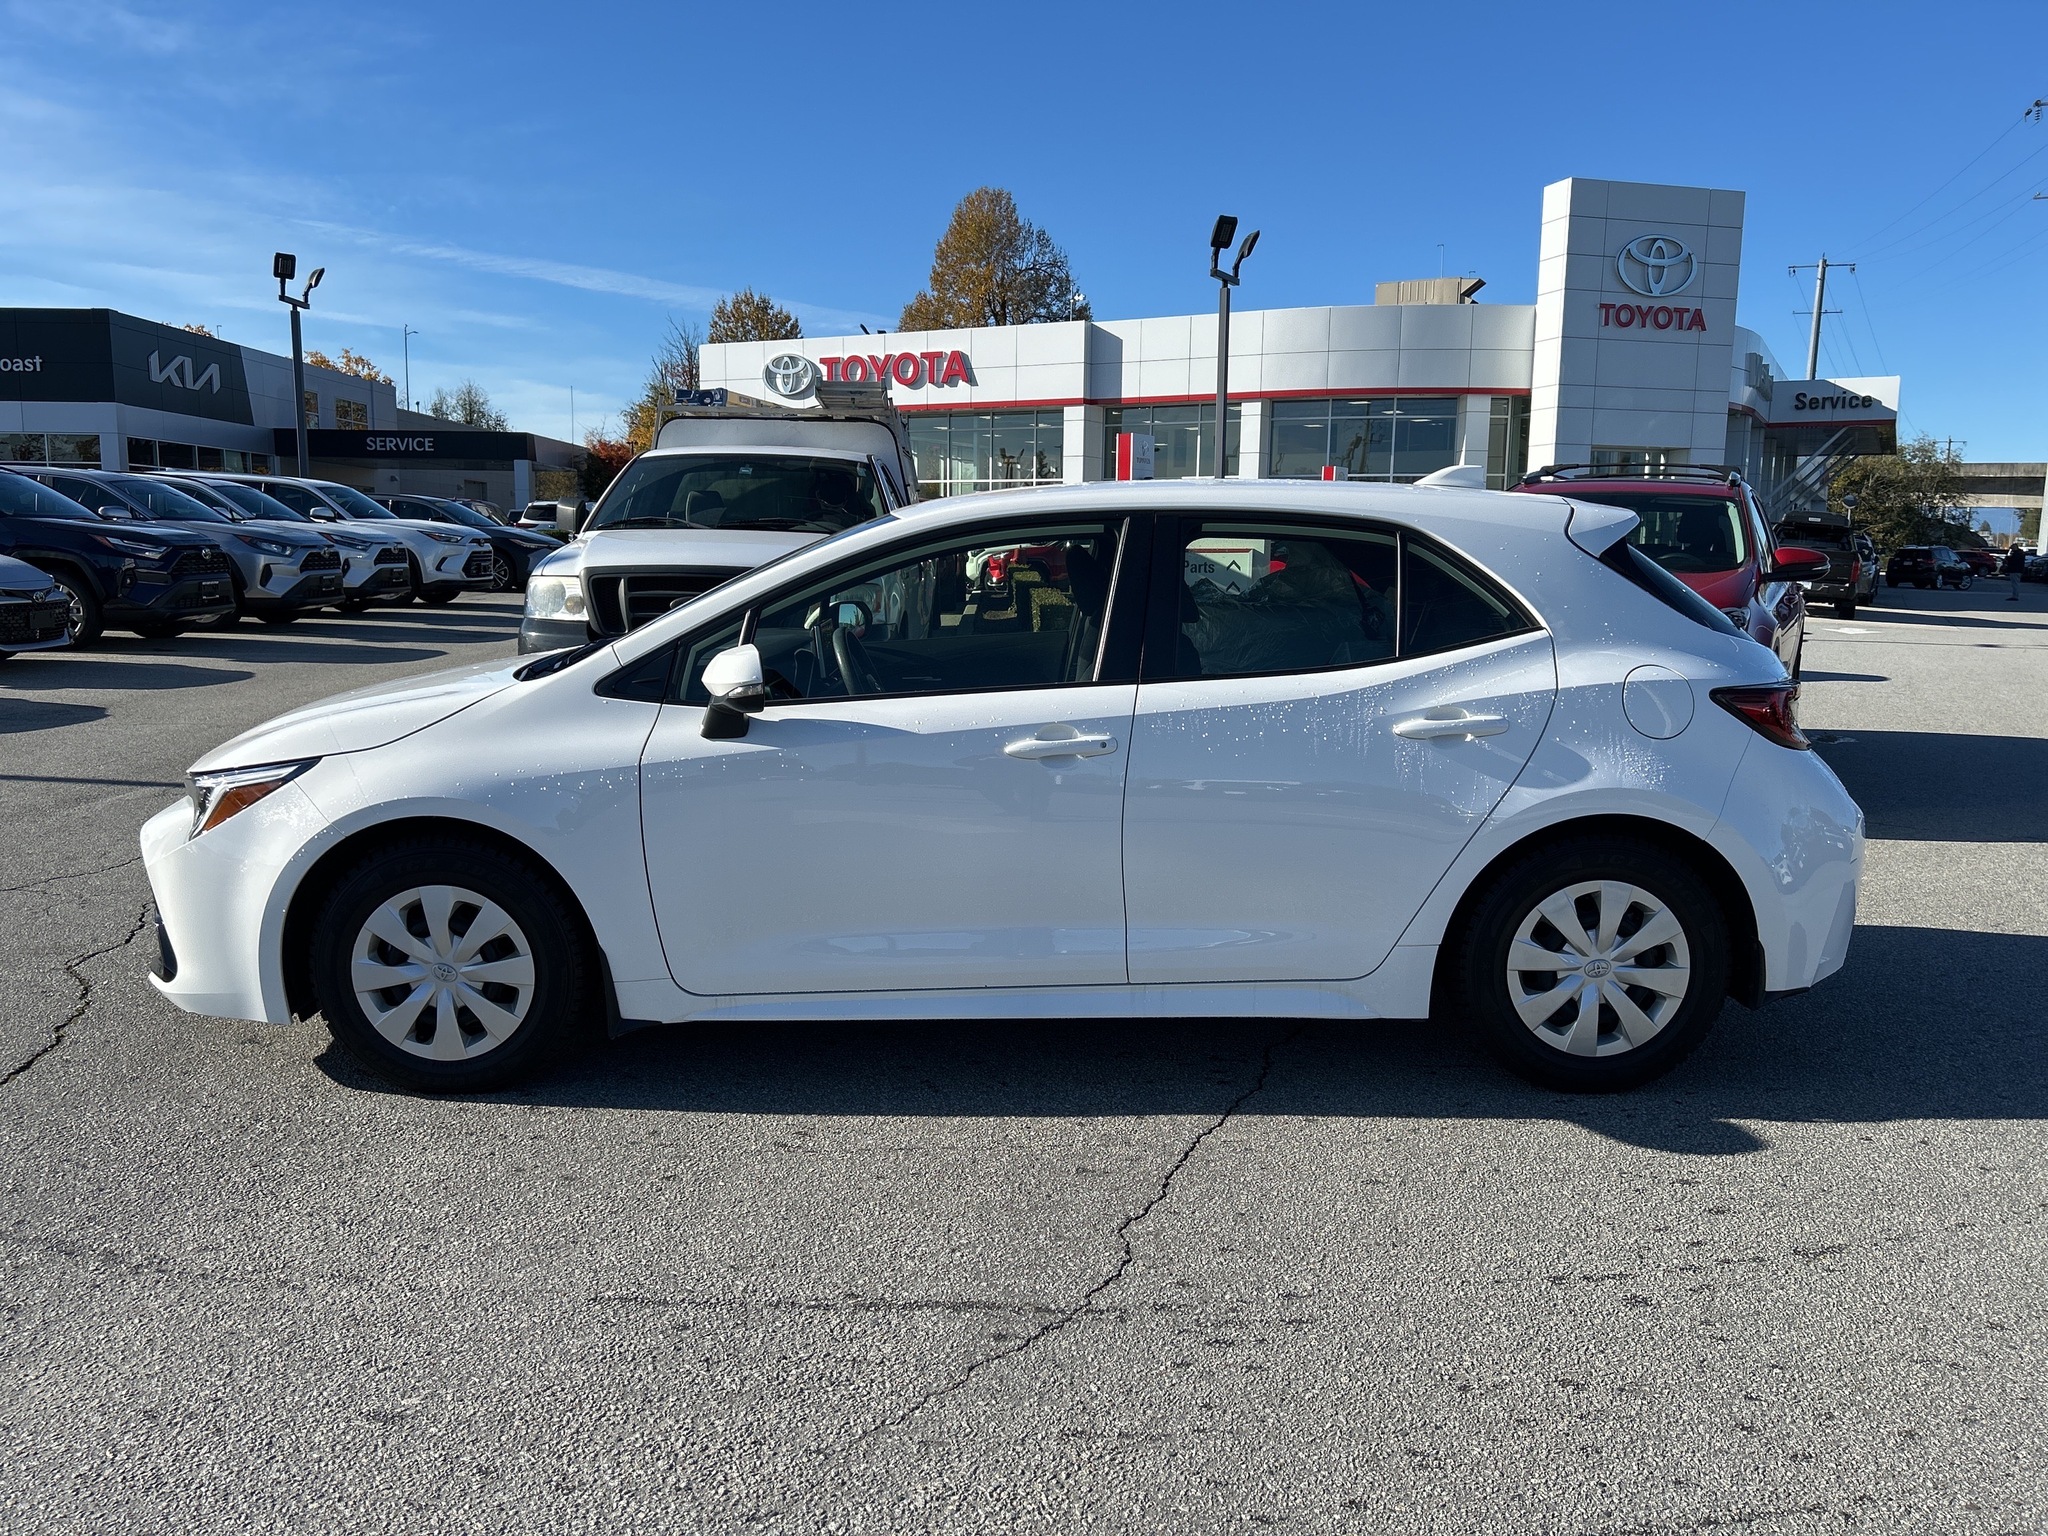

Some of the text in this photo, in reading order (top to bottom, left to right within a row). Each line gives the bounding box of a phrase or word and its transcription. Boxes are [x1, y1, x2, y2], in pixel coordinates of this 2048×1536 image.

[1599, 303, 1706, 331] TOYOTA
[148, 350, 220, 394] KIA
[819, 350, 969, 386] TOYOTA
[1794, 391, 1873, 410] Service
[366, 437, 434, 451] SERVICE
